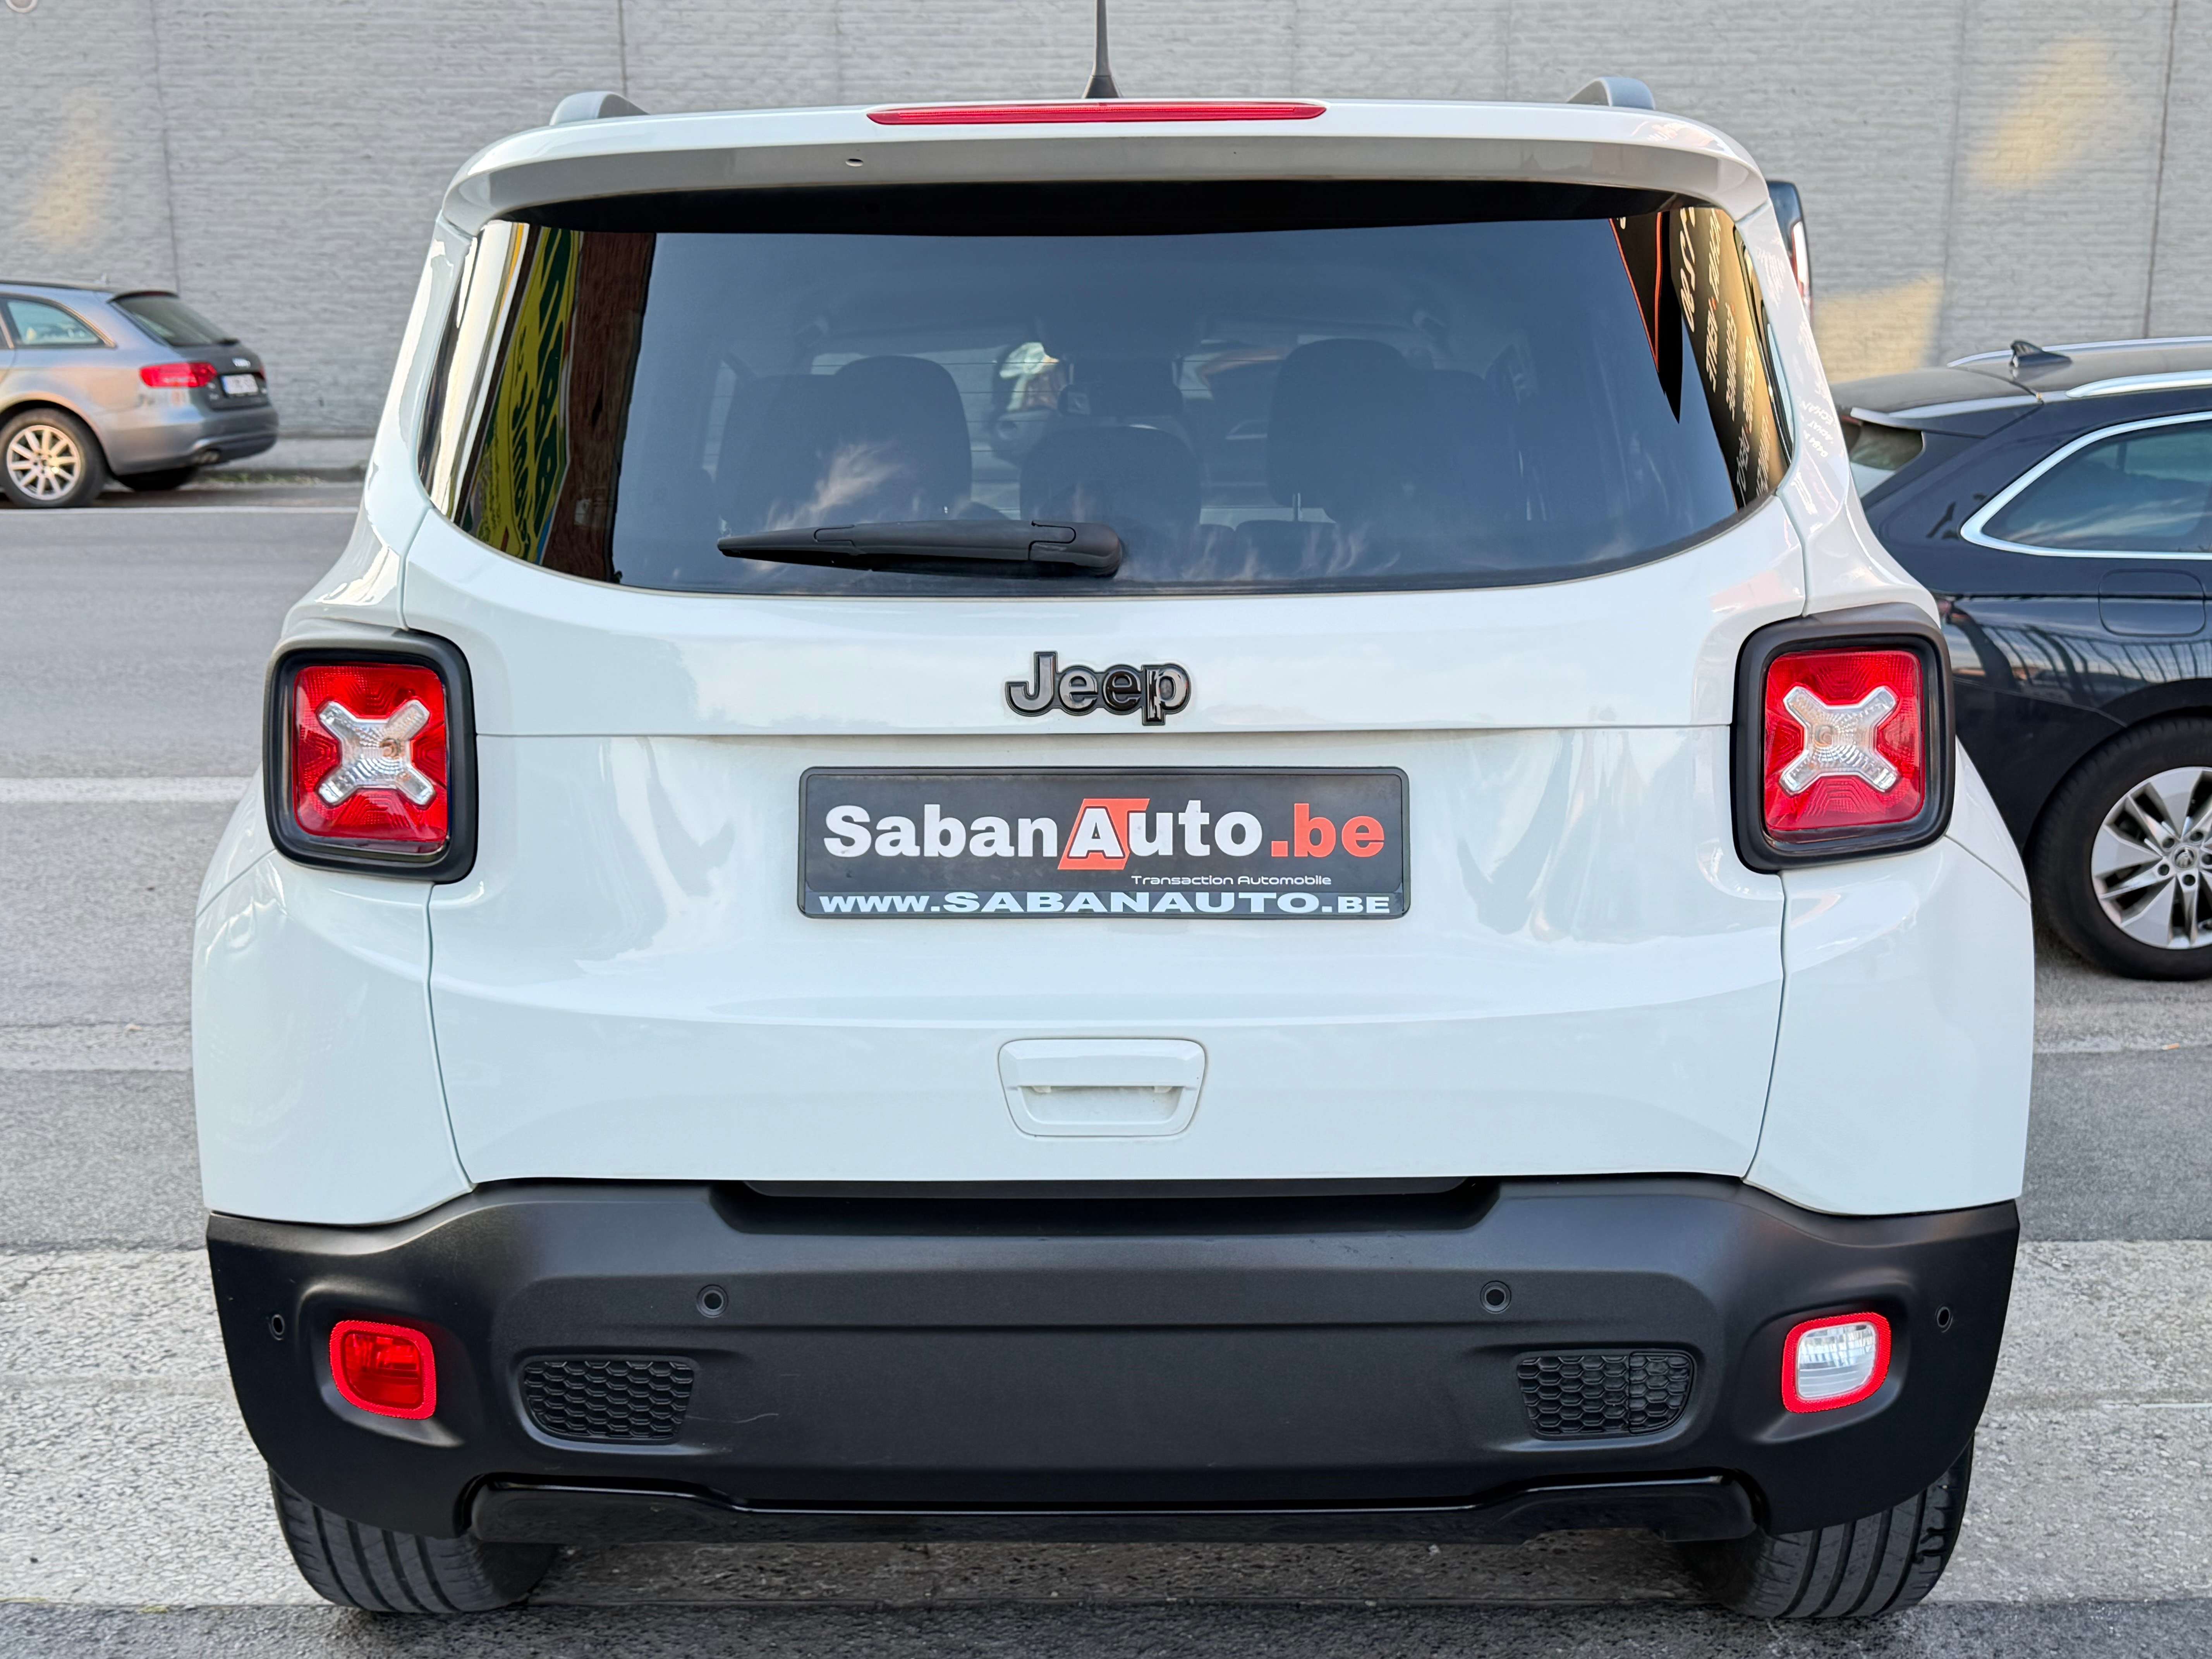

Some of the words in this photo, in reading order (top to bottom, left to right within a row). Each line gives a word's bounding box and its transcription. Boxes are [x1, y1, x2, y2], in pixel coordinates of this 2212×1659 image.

[1005, 651, 1191, 726] Jeep
[1131, 875, 1234, 885] Transaction
[1238, 875, 1332, 885] Automobile
